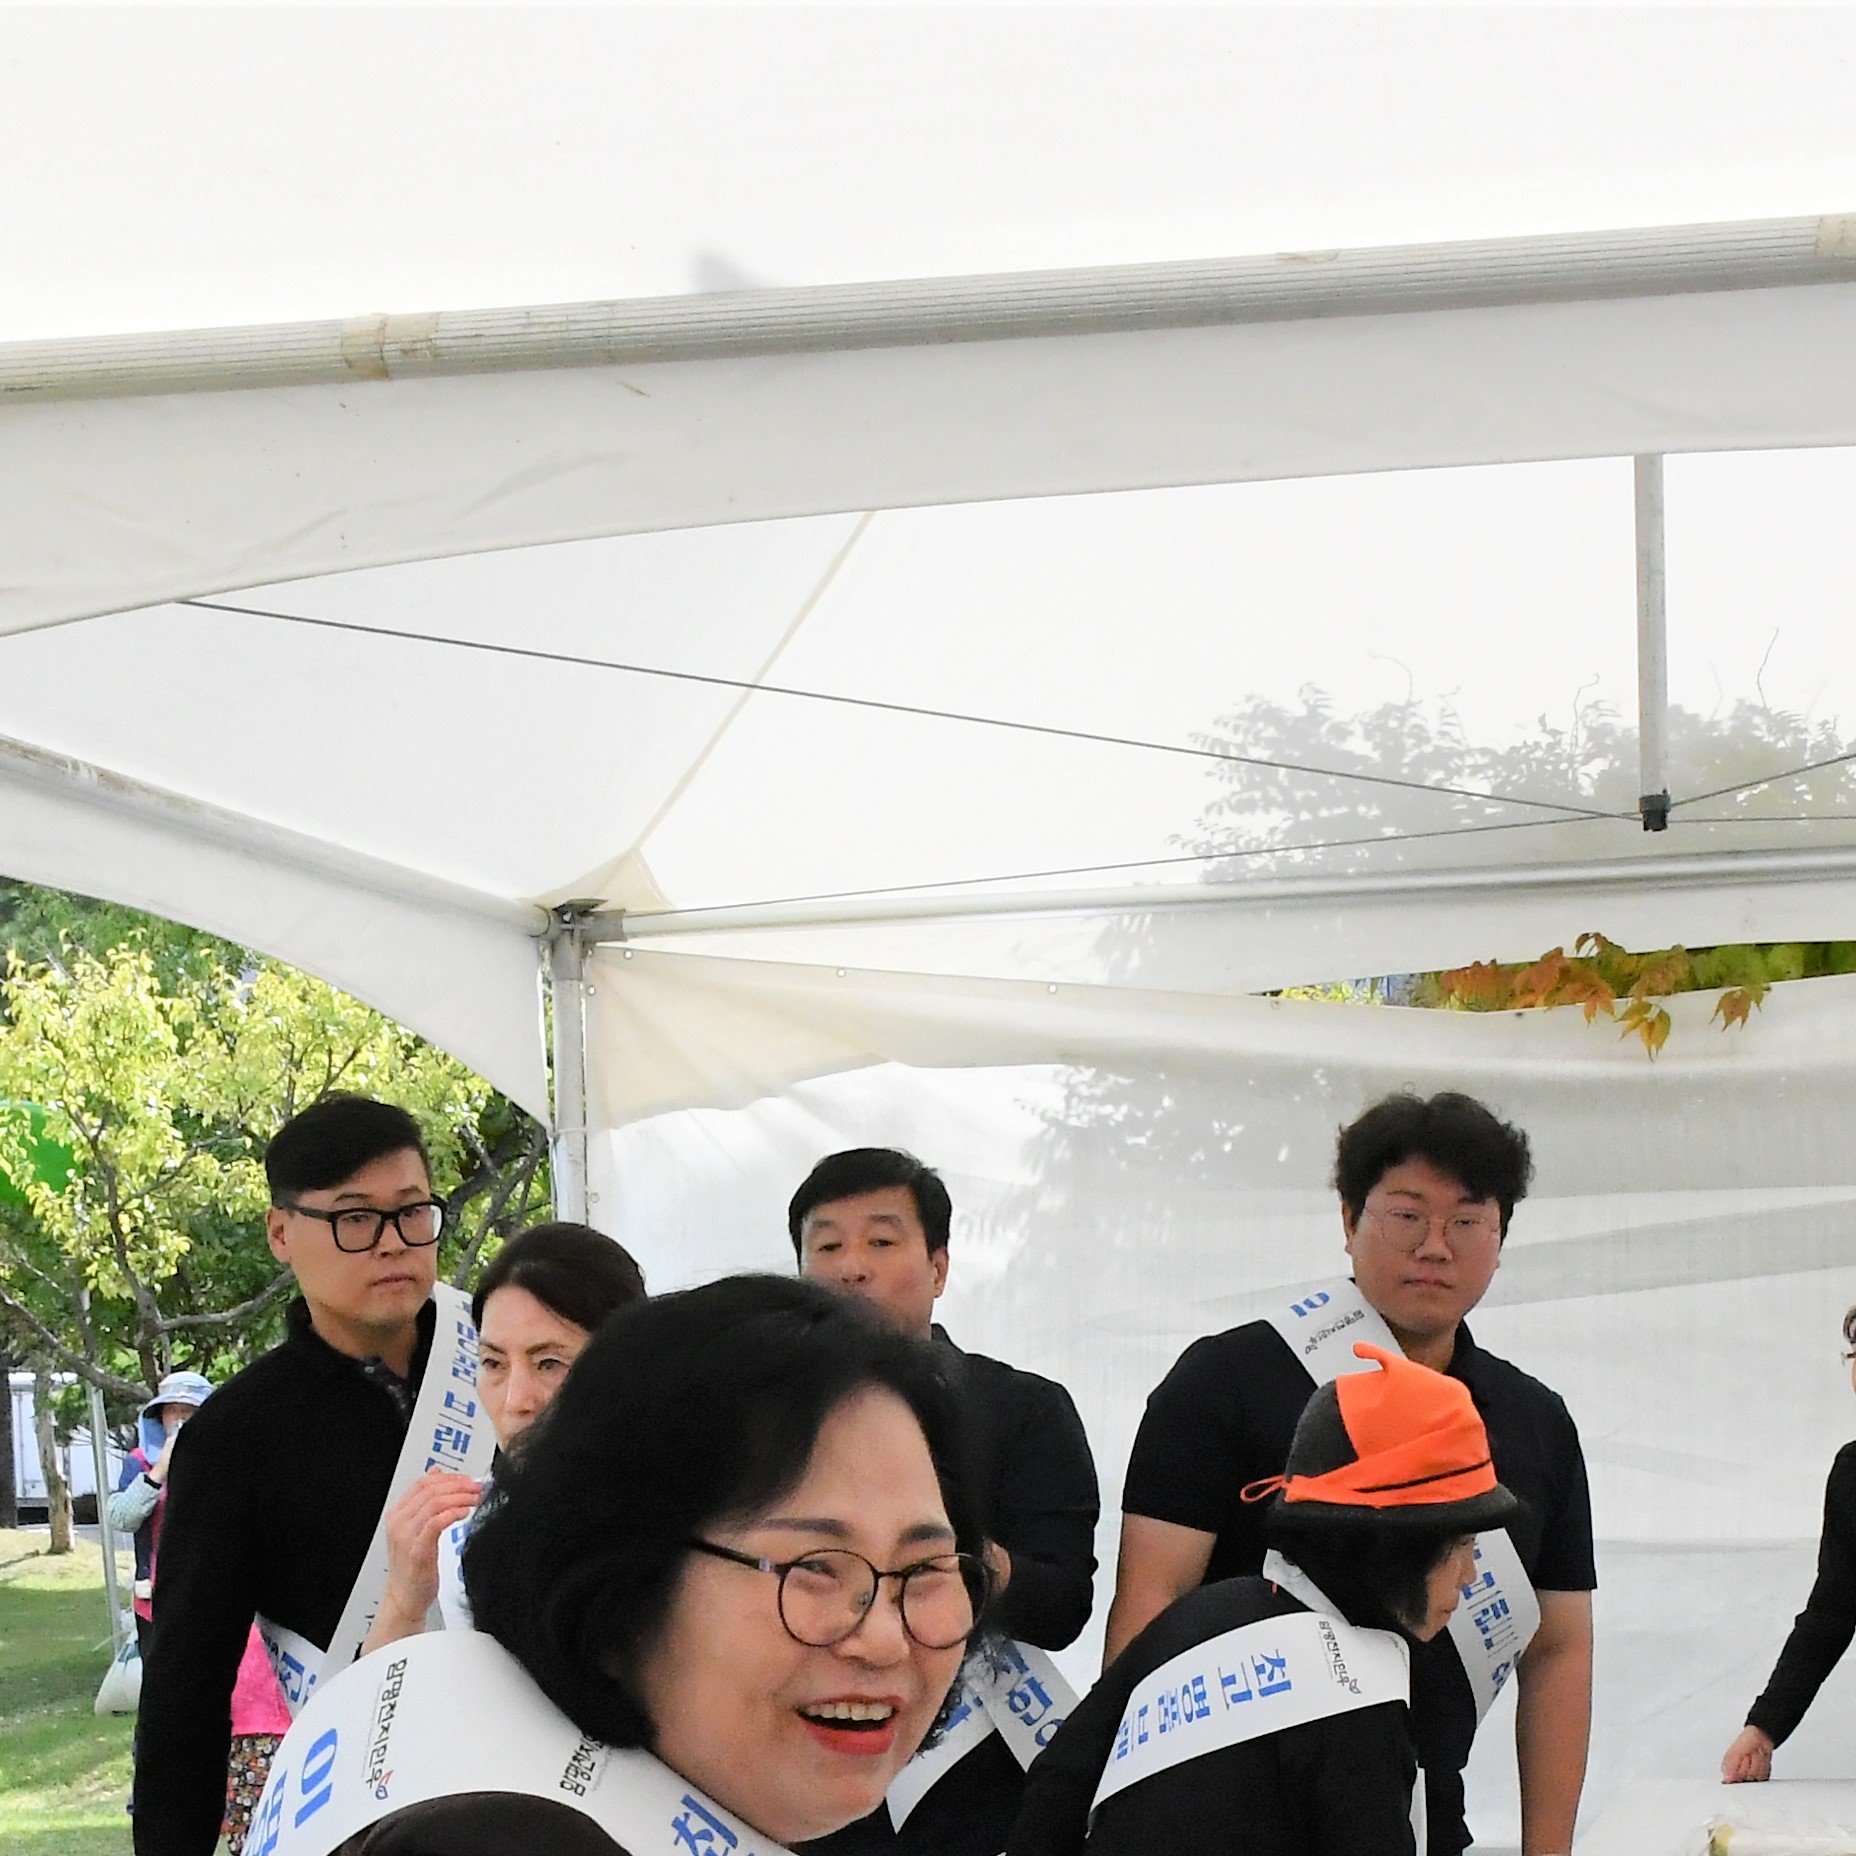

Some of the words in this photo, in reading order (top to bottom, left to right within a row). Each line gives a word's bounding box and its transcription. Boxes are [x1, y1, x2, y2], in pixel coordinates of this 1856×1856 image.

[1157, 1674, 1211, 1733] 명품
[1217, 1649, 1292, 1711] 최고
[366, 1657, 408, 1791] 함평천지한우
[294, 1728, 338, 1830] 이
